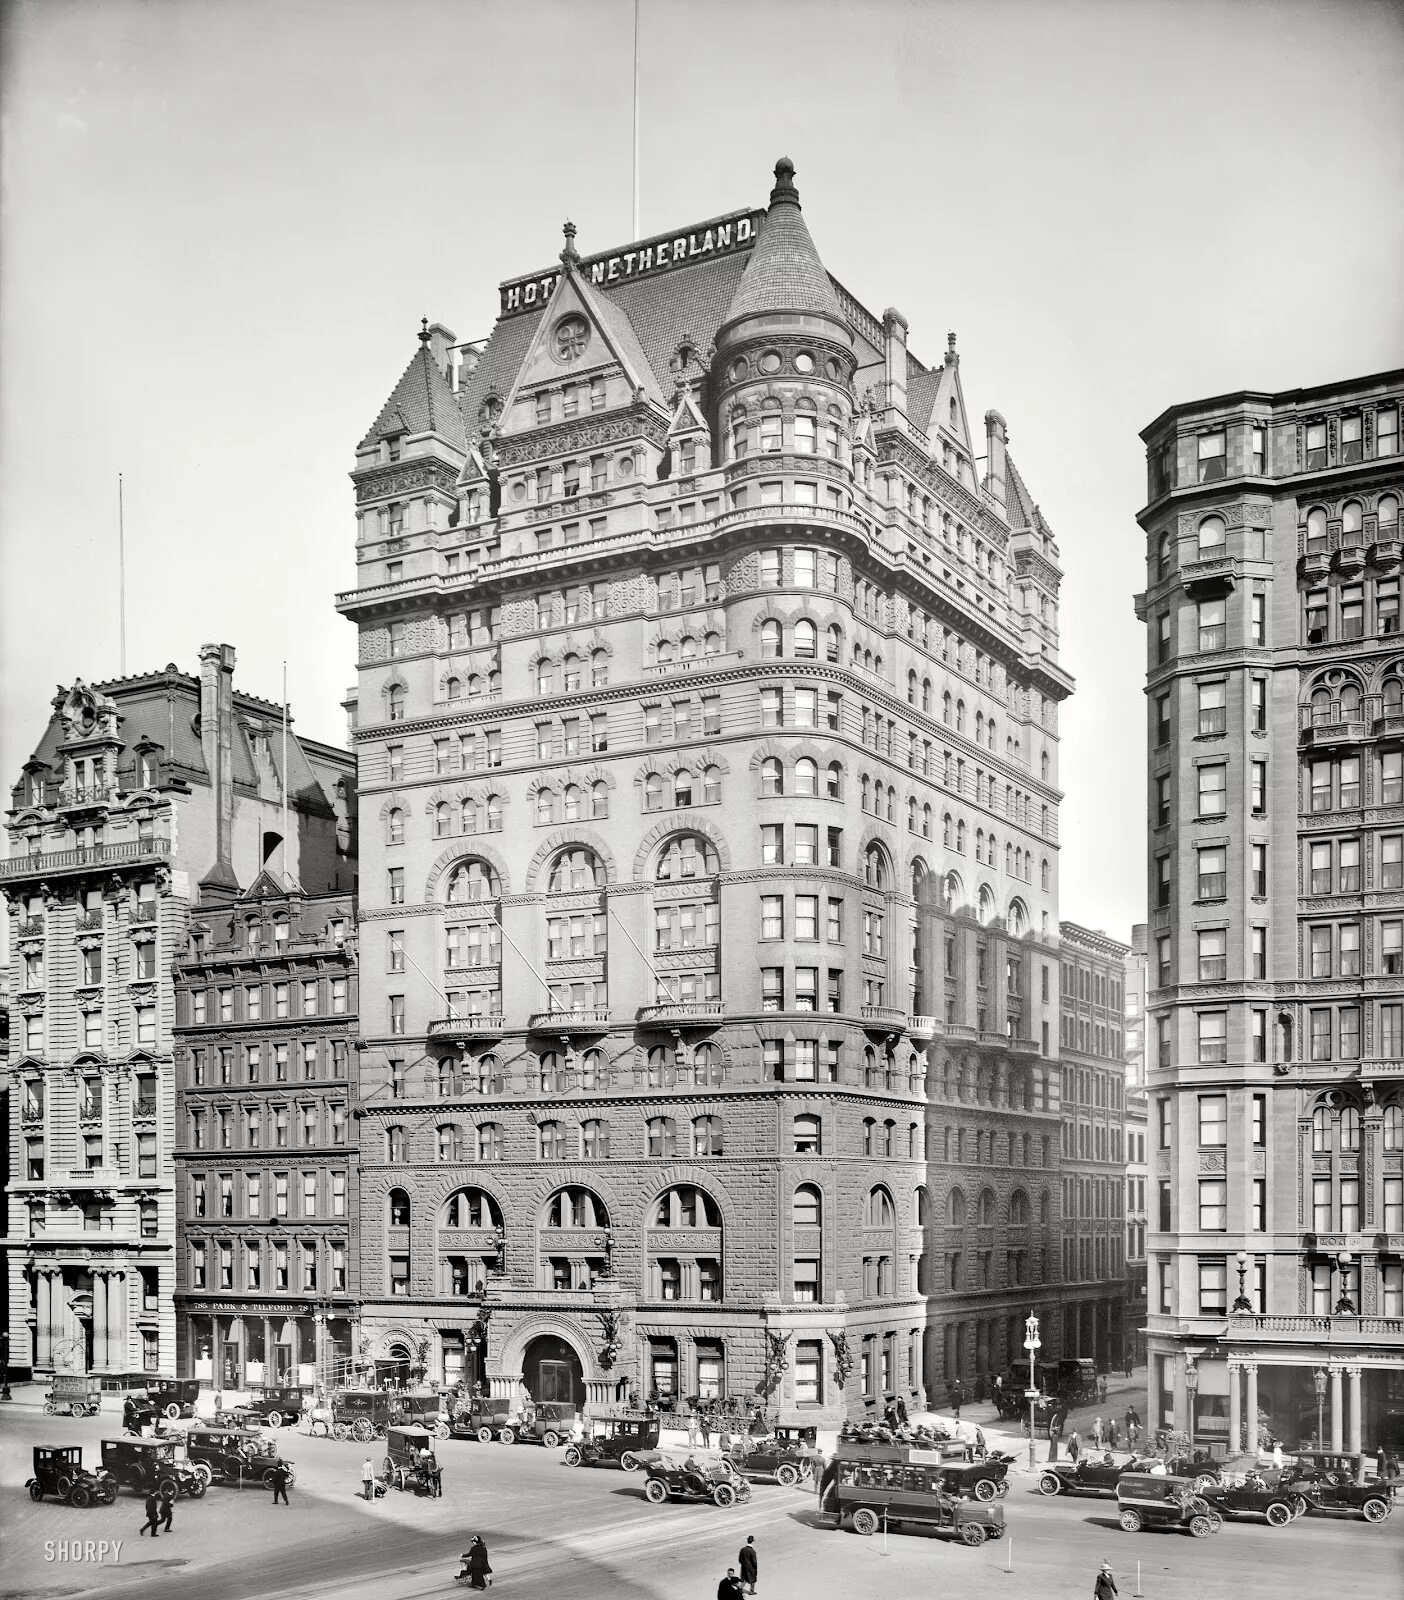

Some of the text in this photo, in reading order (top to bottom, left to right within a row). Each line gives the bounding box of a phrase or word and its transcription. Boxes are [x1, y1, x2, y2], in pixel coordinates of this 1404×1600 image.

[512, 1291, 535, 1300] HOTEL
[212, 1302, 236, 1310] PARK
[251, 1303, 293, 1311] TILFORD
